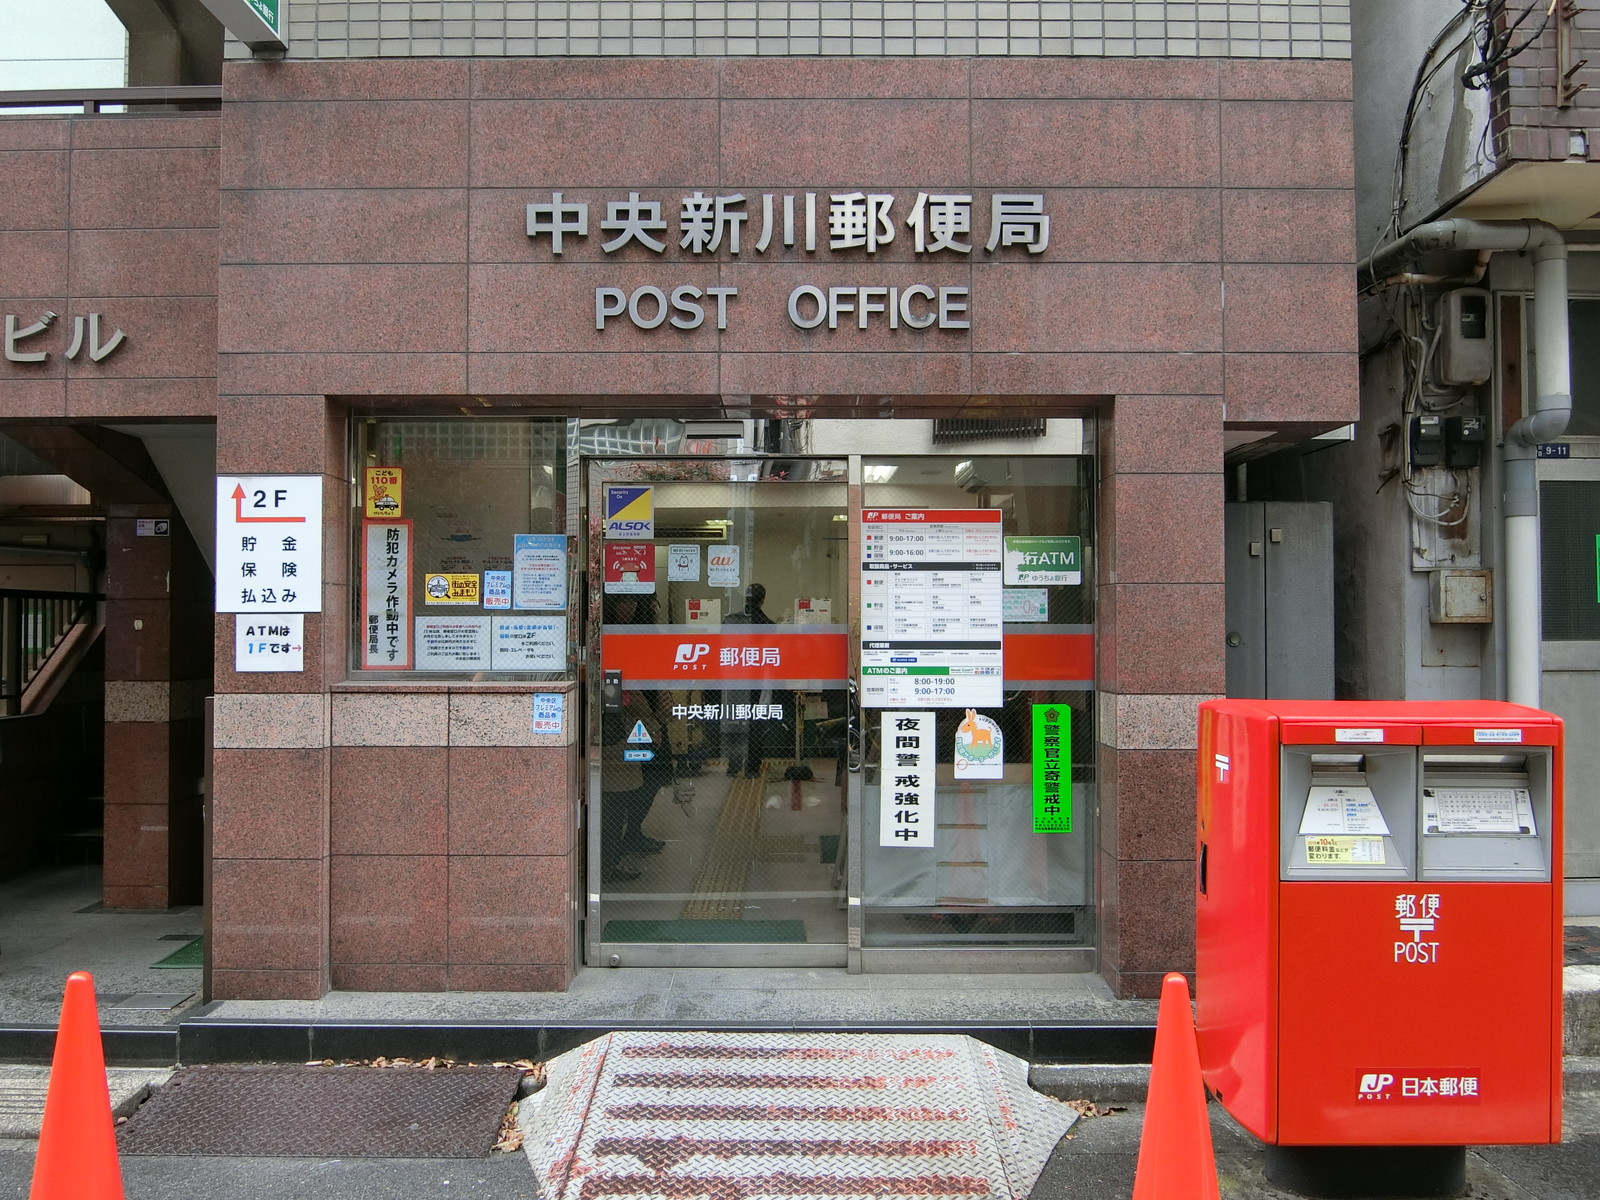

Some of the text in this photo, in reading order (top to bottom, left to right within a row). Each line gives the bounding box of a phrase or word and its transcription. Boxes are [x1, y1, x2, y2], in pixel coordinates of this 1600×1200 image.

[526, 192, 1050, 254] 中央新川郵便局
[595, 285, 970, 330] POST OFFICE
[5, 311, 128, 362] ビル
[1545, 446, 1567, 456] 9-11
[253, 490, 287, 508] 2F
[608, 522, 651, 531] ALSOK
[241, 536, 297, 551] 貯金
[710, 556, 735, 566] au
[241, 562, 297, 577] 保険
[1031, 574, 1068, 582] ゆうちょ銀行
[241, 588, 297, 603] 払込み
[386, 528, 400, 662] 防犯カメラ作動中です
[485, 597, 509, 605] 販売中
[245, 625, 290, 637] ATMは
[368, 615, 379, 654] 郵便局長
[247, 642, 291, 654] 1Fです
[675, 644, 781, 667] JP 郵便局
[914, 677, 955, 685] 8:00-19:00
[914, 687, 955, 695] 9:00-17:00
[672, 703, 784, 722] 中央新川郵便局
[535, 720, 560, 729] 販売中
[1044, 724, 1061, 816] 警察官立寄警戒中
[895, 717, 921, 842] 夜間警戒強化中
[1395, 893, 1440, 918] 郵便
[1394, 942, 1440, 963] POST
[1359, 1074, 1478, 1097] JP 日本郵便
